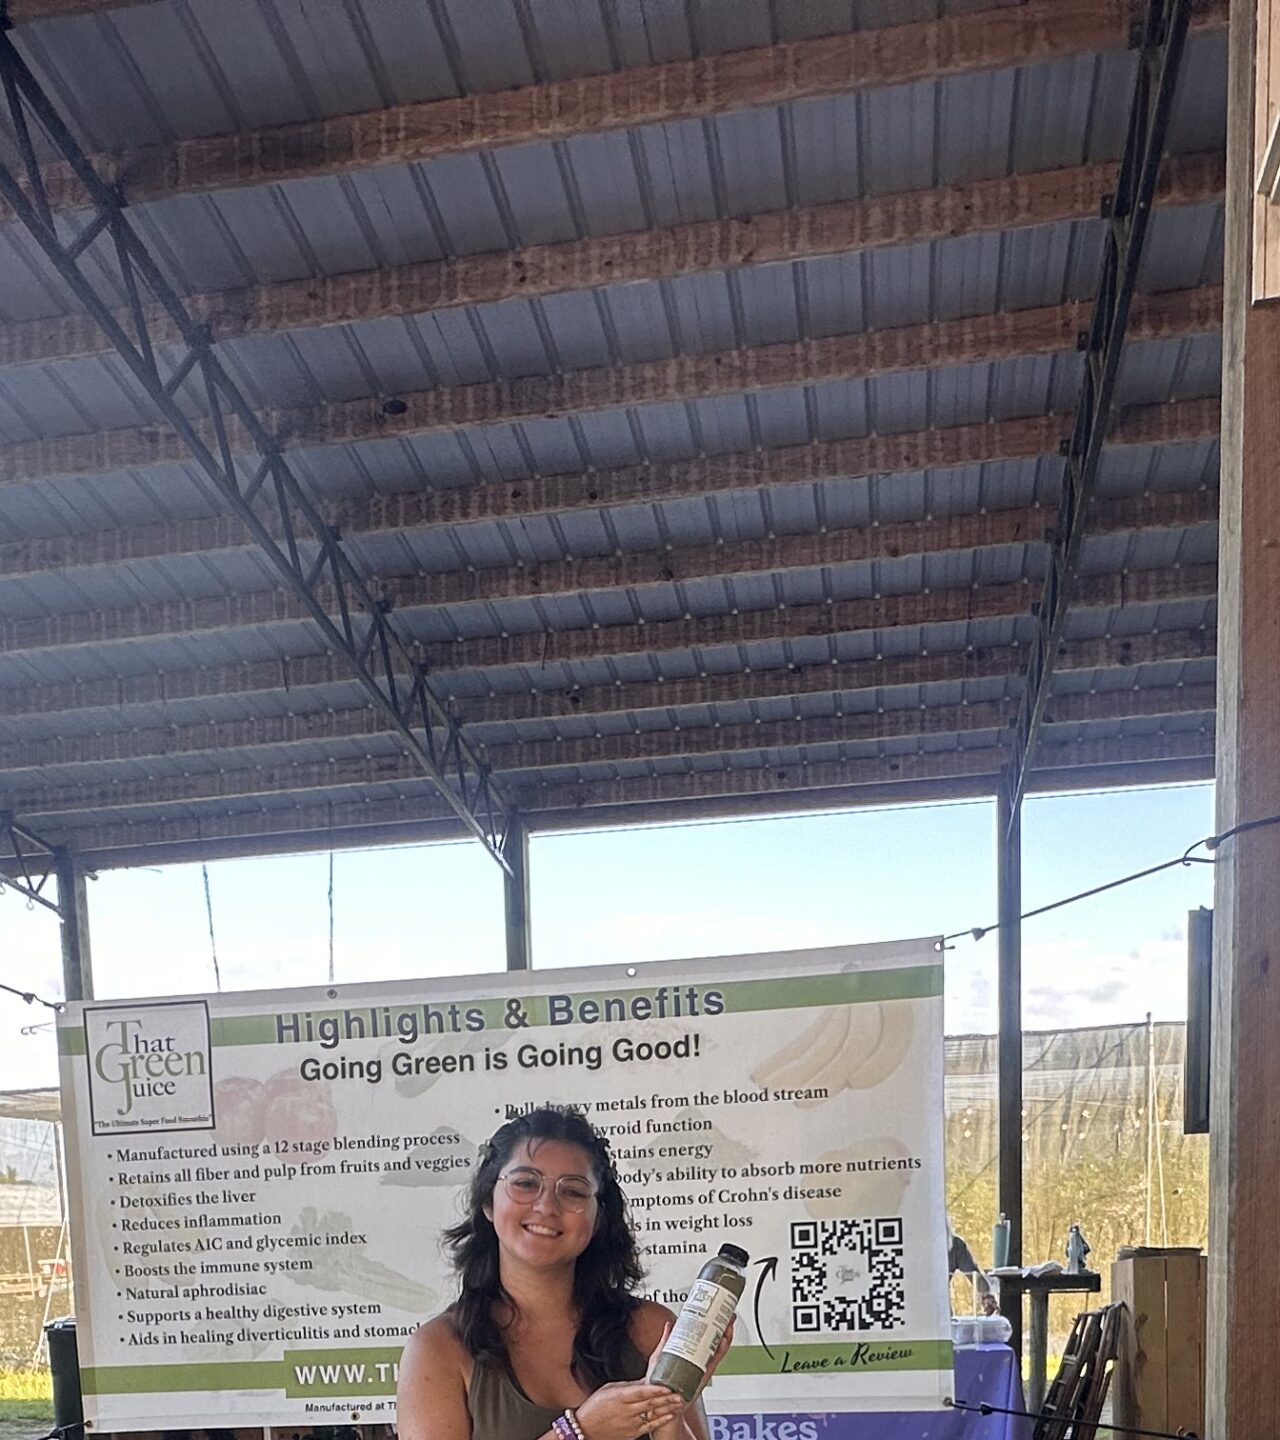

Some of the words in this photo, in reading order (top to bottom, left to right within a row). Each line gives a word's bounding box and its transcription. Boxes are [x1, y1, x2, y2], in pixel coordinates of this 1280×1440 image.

[276, 1003, 485, 1048] Highlights
[504, 998, 529, 1030] &
[548, 986, 725, 1026] Benefits
[107, 1020, 175, 1055] That
[95, 1043, 205, 1083] Green
[300, 1056, 381, 1084] Going
[392, 1052, 474, 1077] Green
[485, 1047, 508, 1071] is
[518, 1042, 601, 1071] Going
[613, 1033, 699, 1063] Good!
[117, 1063, 176, 1115] Juice
[596, 1095, 646, 1112] metals
[651, 1093, 689, 1109] from
[694, 1091, 719, 1106] the
[724, 1087, 768, 1104] blood
[774, 1087, 828, 1102] stream
[647, 1117, 712, 1134] function
[117, 1143, 217, 1163] Manufactured
[222, 1142, 259, 1159] using
[263, 1144, 270, 1155] a
[275, 1139, 288, 1154] 12
[293, 1140, 329, 1156] stage
[333, 1134, 400, 1152] blending
[404, 1133, 460, 1151] process
[659, 1144, 713, 1160] energy
[118, 1170, 170, 1186] Retains
[175, 1168, 191, 1183] all
[196, 1167, 229, 1182] fiber
[234, 1164, 259, 1180] and
[264, 1163, 296, 1182] pulp
[301, 1161, 336, 1176] from
[341, 1159, 379, 1174] fruits
[384, 1156, 411, 1172] and
[415, 1154, 470, 1173] veggies
[667, 1165, 717, 1184] ability
[722, 1167, 736, 1179] to
[741, 1160, 795, 1178] absorb
[800, 1162, 841, 1175] more
[847, 1156, 921, 1173] nutrients
[120, 1192, 192, 1209] Detoxifies
[196, 1190, 219, 1205] the
[223, 1189, 256, 1204] liver
[698, 1189, 716, 1205] of
[718, 1186, 778, 1204] Crohn's
[783, 1185, 841, 1200] disease
[122, 1216, 180, 1232] Reduces
[184, 1212, 281, 1229] inflammation
[646, 1217, 660, 1231] in
[665, 1214, 719, 1233] weight
[724, 1213, 752, 1228] loss
[124, 1239, 191, 1258] Regulates
[227, 1235, 252, 1250] and
[256, 1233, 321, 1253] glycemic
[326, 1230, 367, 1246] index
[645, 1240, 707, 1255] stamina
[126, 1284, 179, 1301] Natural
[183, 1282, 266, 1302] aphrodisiac
[129, 1331, 159, 1346] Aids
[164, 1331, 177, 1345] in
[181, 1329, 234, 1347] healing
[237, 1325, 329, 1342] diverticulitis
[334, 1324, 360, 1339] and
[781, 1353, 828, 1373] Leave
[835, 1356, 846, 1367] a
[850, 1343, 914, 1365] Review
